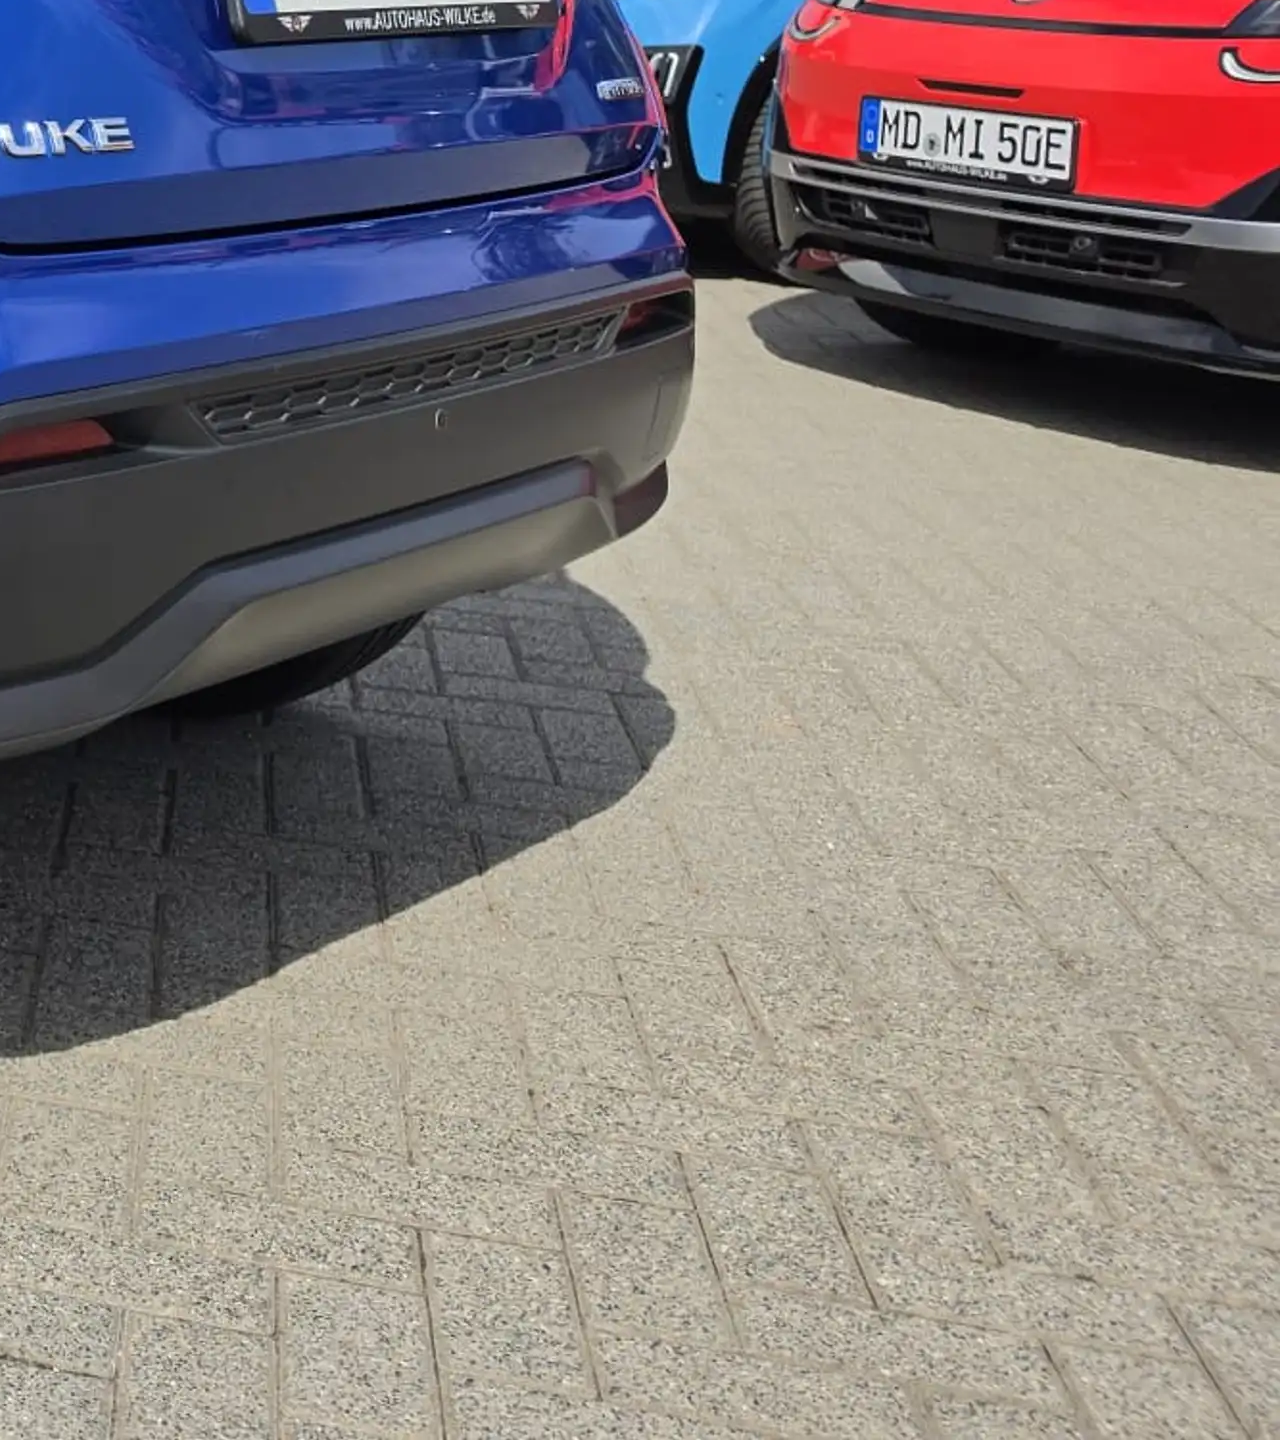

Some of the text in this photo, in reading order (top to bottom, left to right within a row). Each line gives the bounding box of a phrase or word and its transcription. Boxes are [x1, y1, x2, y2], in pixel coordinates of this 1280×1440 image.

[344, 6, 497, 33] www.AUTOHAUS-WILKE.de
[880, 107, 1067, 171] MD MI 50E
